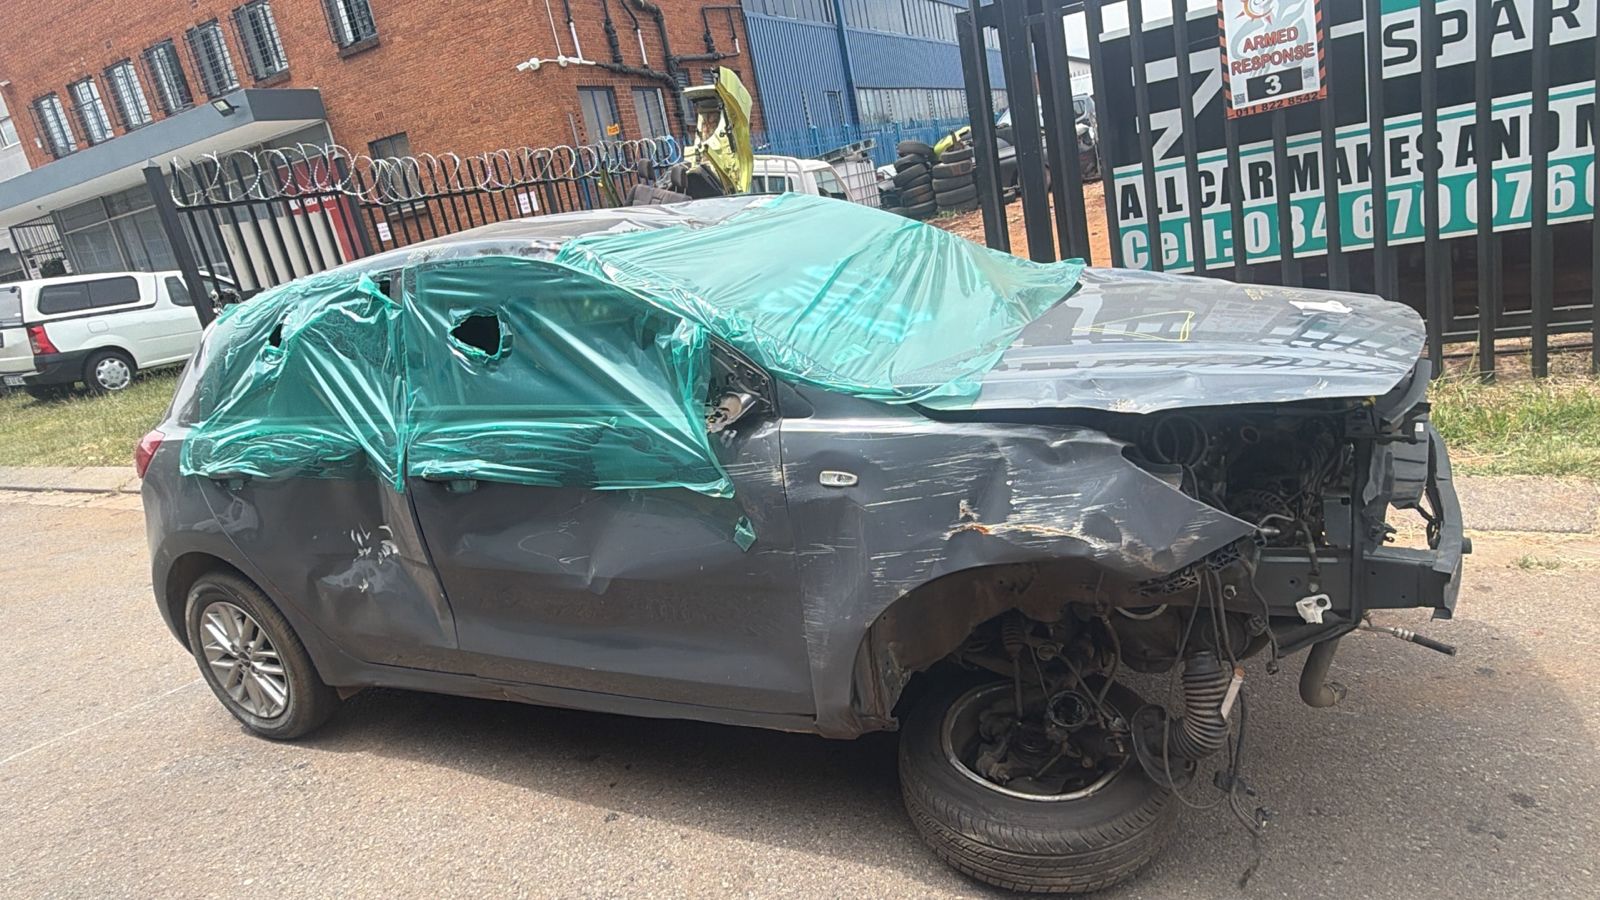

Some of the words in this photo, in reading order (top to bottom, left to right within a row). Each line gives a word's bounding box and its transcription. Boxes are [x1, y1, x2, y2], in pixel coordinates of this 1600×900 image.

[1243, 26, 1298, 53] ARMED
[1231, 42, 1315, 76] RESPONSE
[1264, 75, 1282, 95] 3
[1235, 106, 1257, 117] 011
[1261, 100, 1284, 111] 822
[1287, 92, 1318, 104] 8542
[1120, 177, 1183, 221] AL
